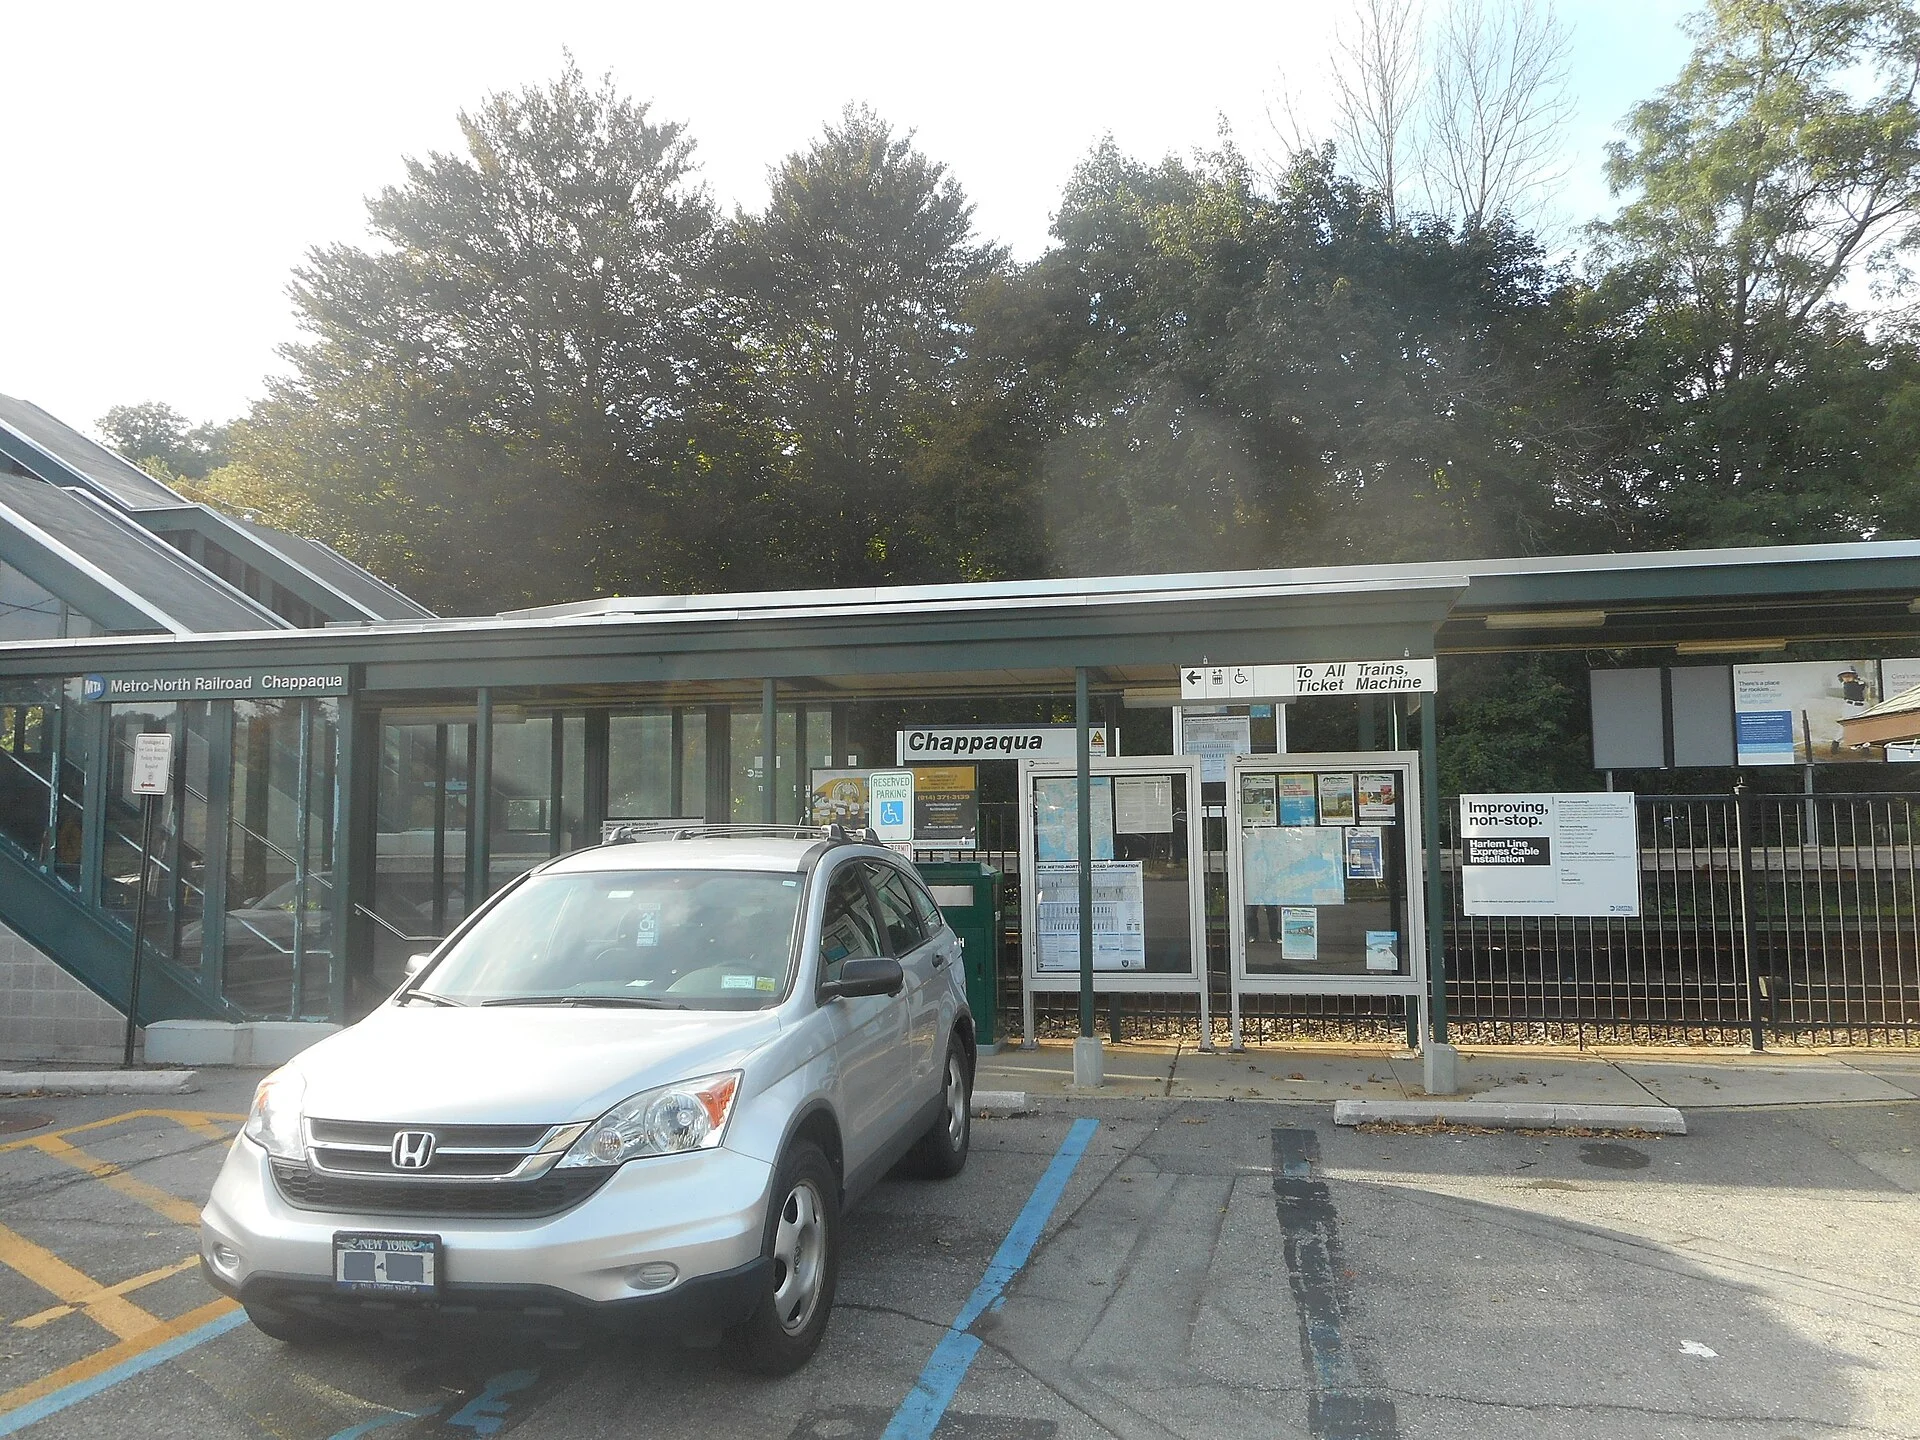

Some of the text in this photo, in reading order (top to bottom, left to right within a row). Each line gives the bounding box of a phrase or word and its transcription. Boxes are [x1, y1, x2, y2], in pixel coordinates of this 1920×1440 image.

[1296, 662, 1409, 679] To All Trains,
[84, 680, 101, 694] MTA
[111, 675, 343, 693] Metro-North Railroad Chappaqua
[1296, 677, 1422, 692] Ticket Machine
[908, 731, 1043, 754] Chappaqua
[873, 777, 910, 787] RESERVED
[876, 789, 907, 798] PARKING
[1468, 800, 1549, 815] Improving,
[1469, 814, 1543, 828] non-stop.
[1469, 839, 1529, 848] Harlem Line
[1470, 847, 1540, 856] Express Cable
[1470, 855, 1525, 863] Installation
[360, 1239, 414, 1251] NEW YORK
